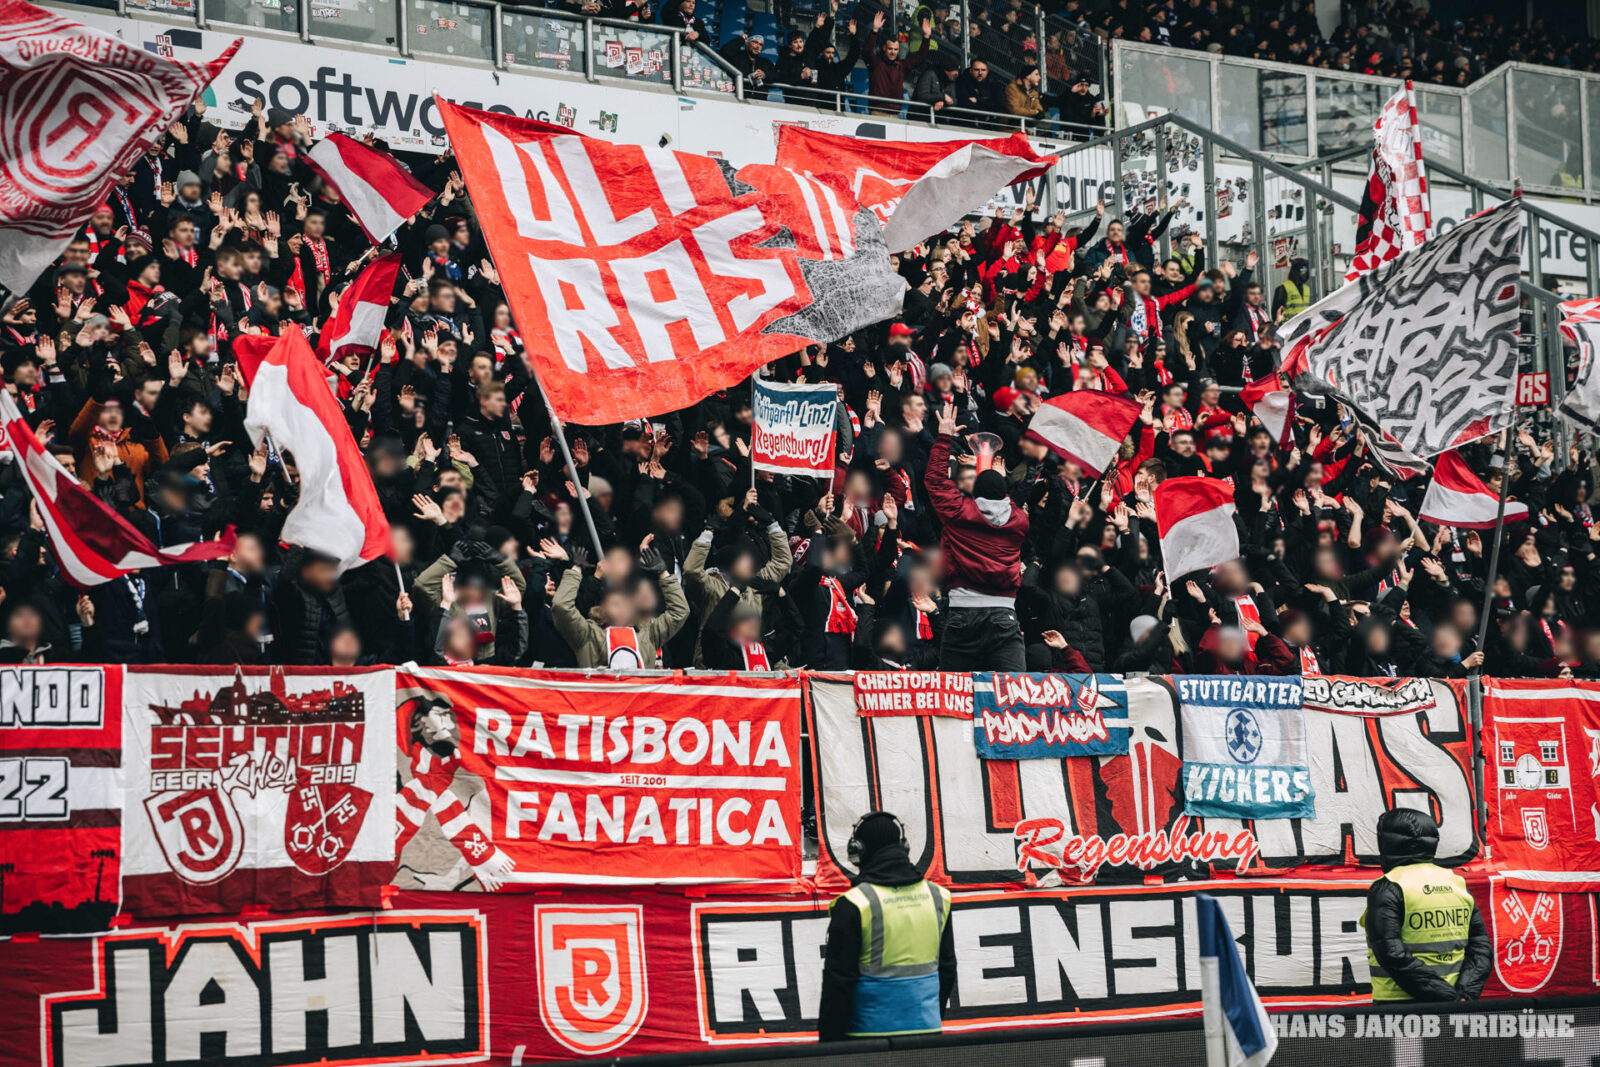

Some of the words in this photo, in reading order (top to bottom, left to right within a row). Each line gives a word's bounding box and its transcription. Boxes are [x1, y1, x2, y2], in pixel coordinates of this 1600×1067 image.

[235, 66, 517, 137] softwa
[525, 109, 550, 123] AG
[529, 206, 796, 374] RAS
[800, 401, 835, 428] Linz!
[756, 424, 829, 461] Regensburg!
[857, 672, 941, 690] CHRISTOPH
[945, 672, 974, 693] FÜR
[1179, 679, 1302, 705] STUTTGARTER
[859, 692, 912, 710] IMMER
[916, 691, 940, 709] BEI
[944, 693, 974, 714] UNS
[473, 707, 792, 768] RATISBONA
[310, 765, 357, 785] 2019
[620, 774, 640, 785] SEIT
[643, 776, 667, 787] 2001
[1185, 765, 1310, 803] KICKERS
[505, 790, 793, 847] FANATICA
[1014, 812, 1260, 883] Regensburg
[1409, 908, 1469, 930] ORDNER
[61, 930, 466, 1066] JAHN
